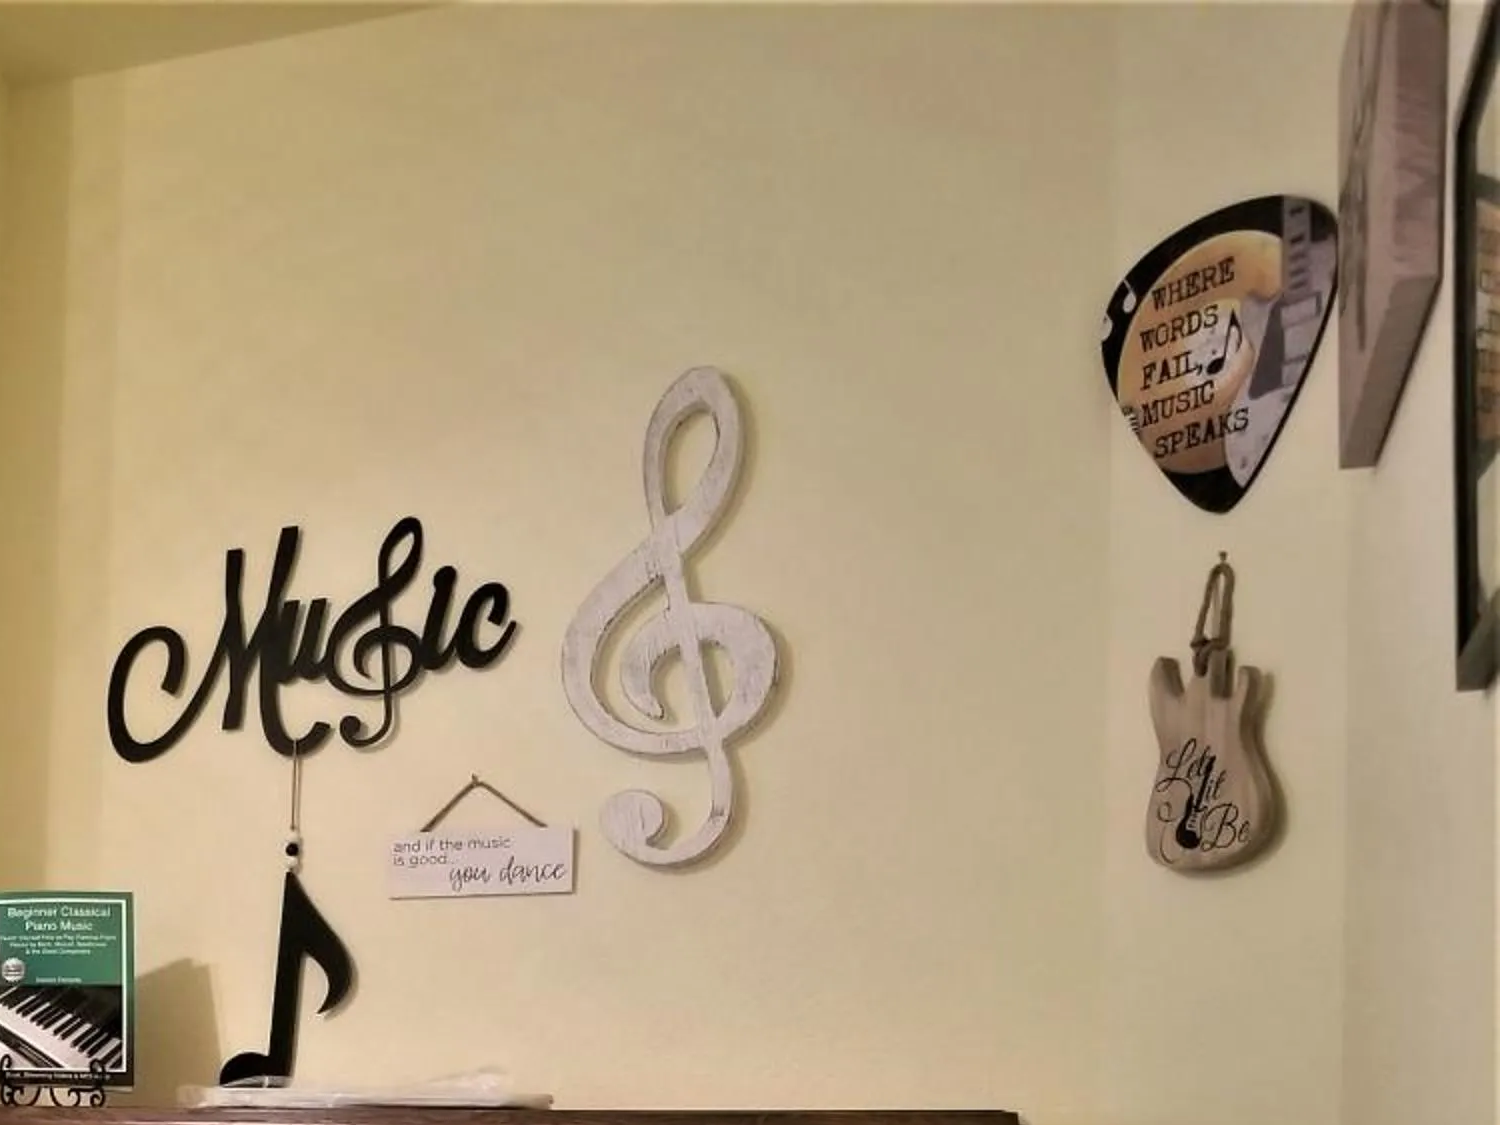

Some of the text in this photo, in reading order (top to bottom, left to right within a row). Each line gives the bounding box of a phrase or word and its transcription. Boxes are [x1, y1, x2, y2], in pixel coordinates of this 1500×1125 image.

[1151, 256, 1235, 312] WHERE
[1140, 304, 1219, 353] WORDS
[1140, 351, 1204, 391] FAIL,
[1140, 380, 1215, 428] MUSIC
[1153, 407, 1250, 460] SPEAKS
[393, 836, 510, 853] and if the music
[393, 854, 405, 866] is
[450, 855, 566, 892] you dance
[7, 905, 111, 920] Beginner Classical
[25, 920, 93, 931] Piano Music
